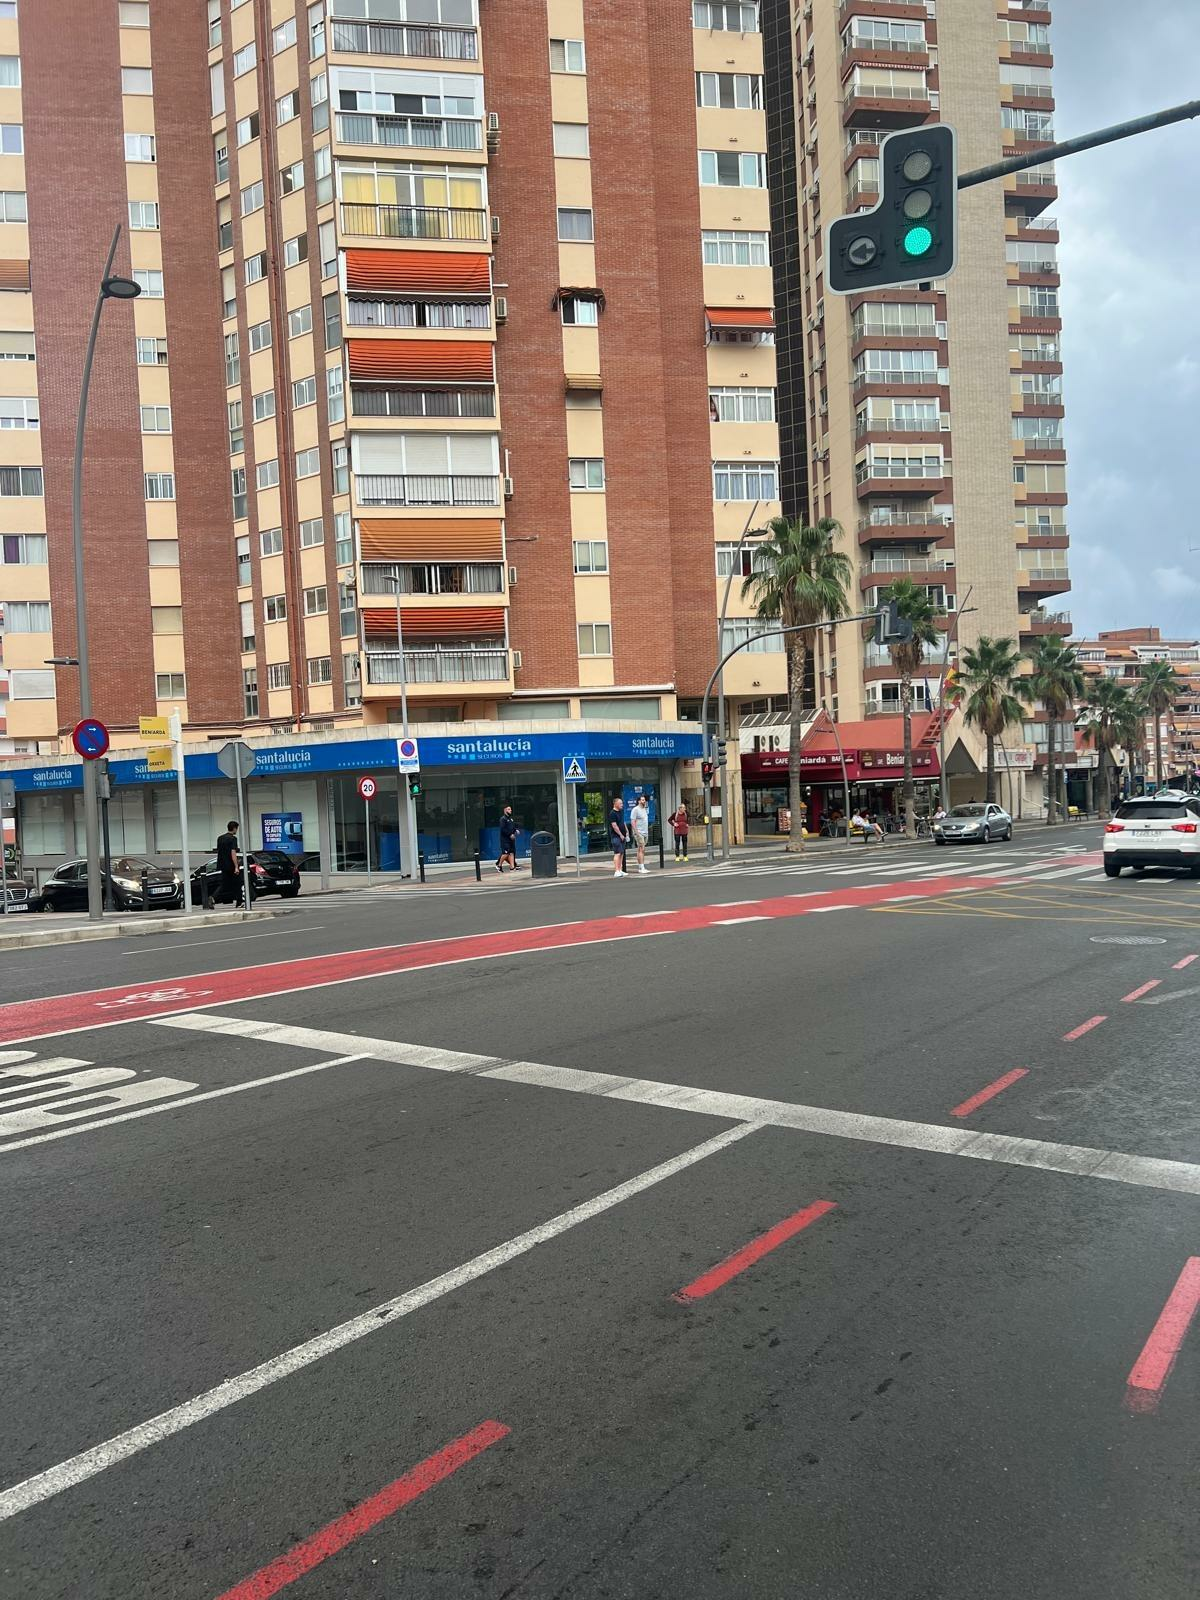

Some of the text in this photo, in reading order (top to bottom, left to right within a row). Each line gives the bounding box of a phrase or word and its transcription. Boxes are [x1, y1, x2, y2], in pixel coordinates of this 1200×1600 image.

[447, 738, 532, 753] santalucía
[256, 750, 311, 764] santalucía
[800, 756, 826, 764] niardá
